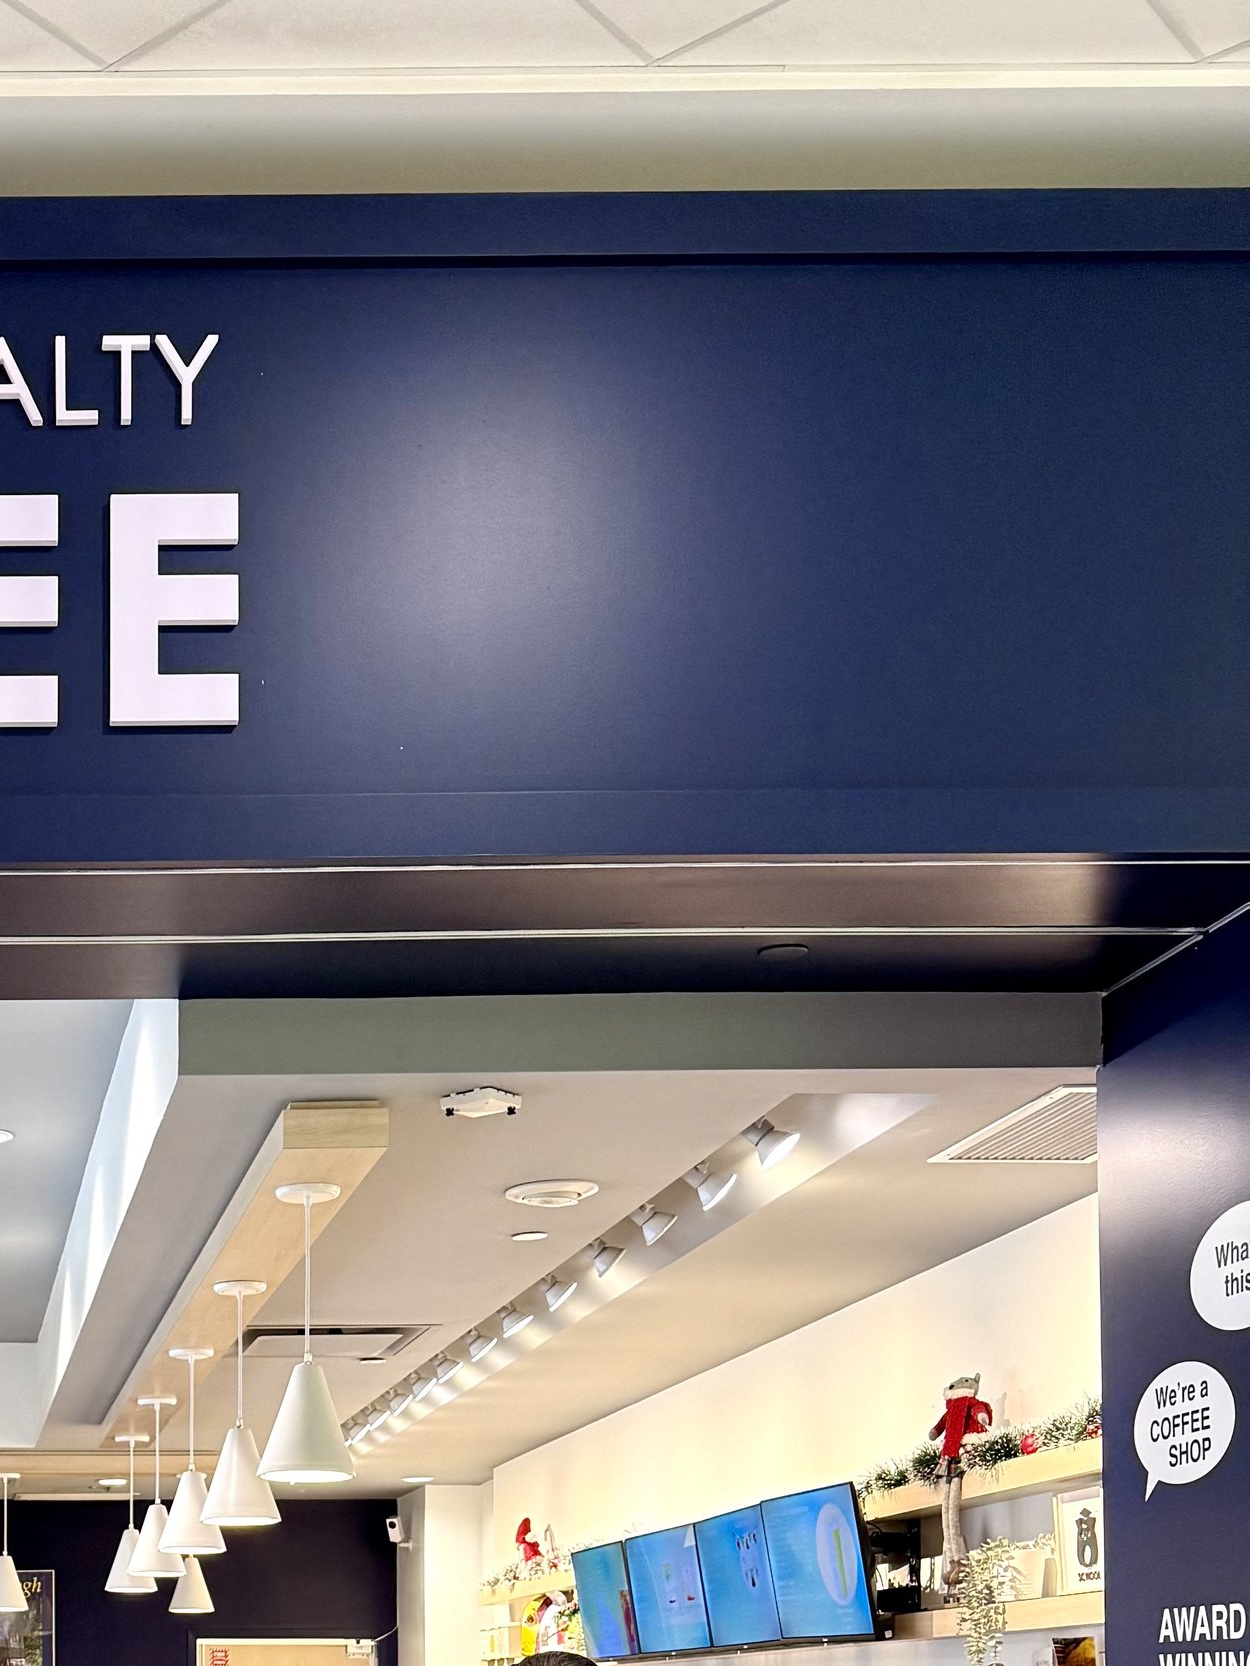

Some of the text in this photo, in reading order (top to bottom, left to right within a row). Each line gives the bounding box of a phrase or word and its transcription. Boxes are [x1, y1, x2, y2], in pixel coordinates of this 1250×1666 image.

[1215, 1240, 1250, 1268] Wha
[1155, 1380, 1208, 1410] We're a
[1150, 1406, 1211, 1442] COFFEE
[1169, 1437, 1212, 1468] SHOP
[1159, 1603, 1246, 1643] AWARD
